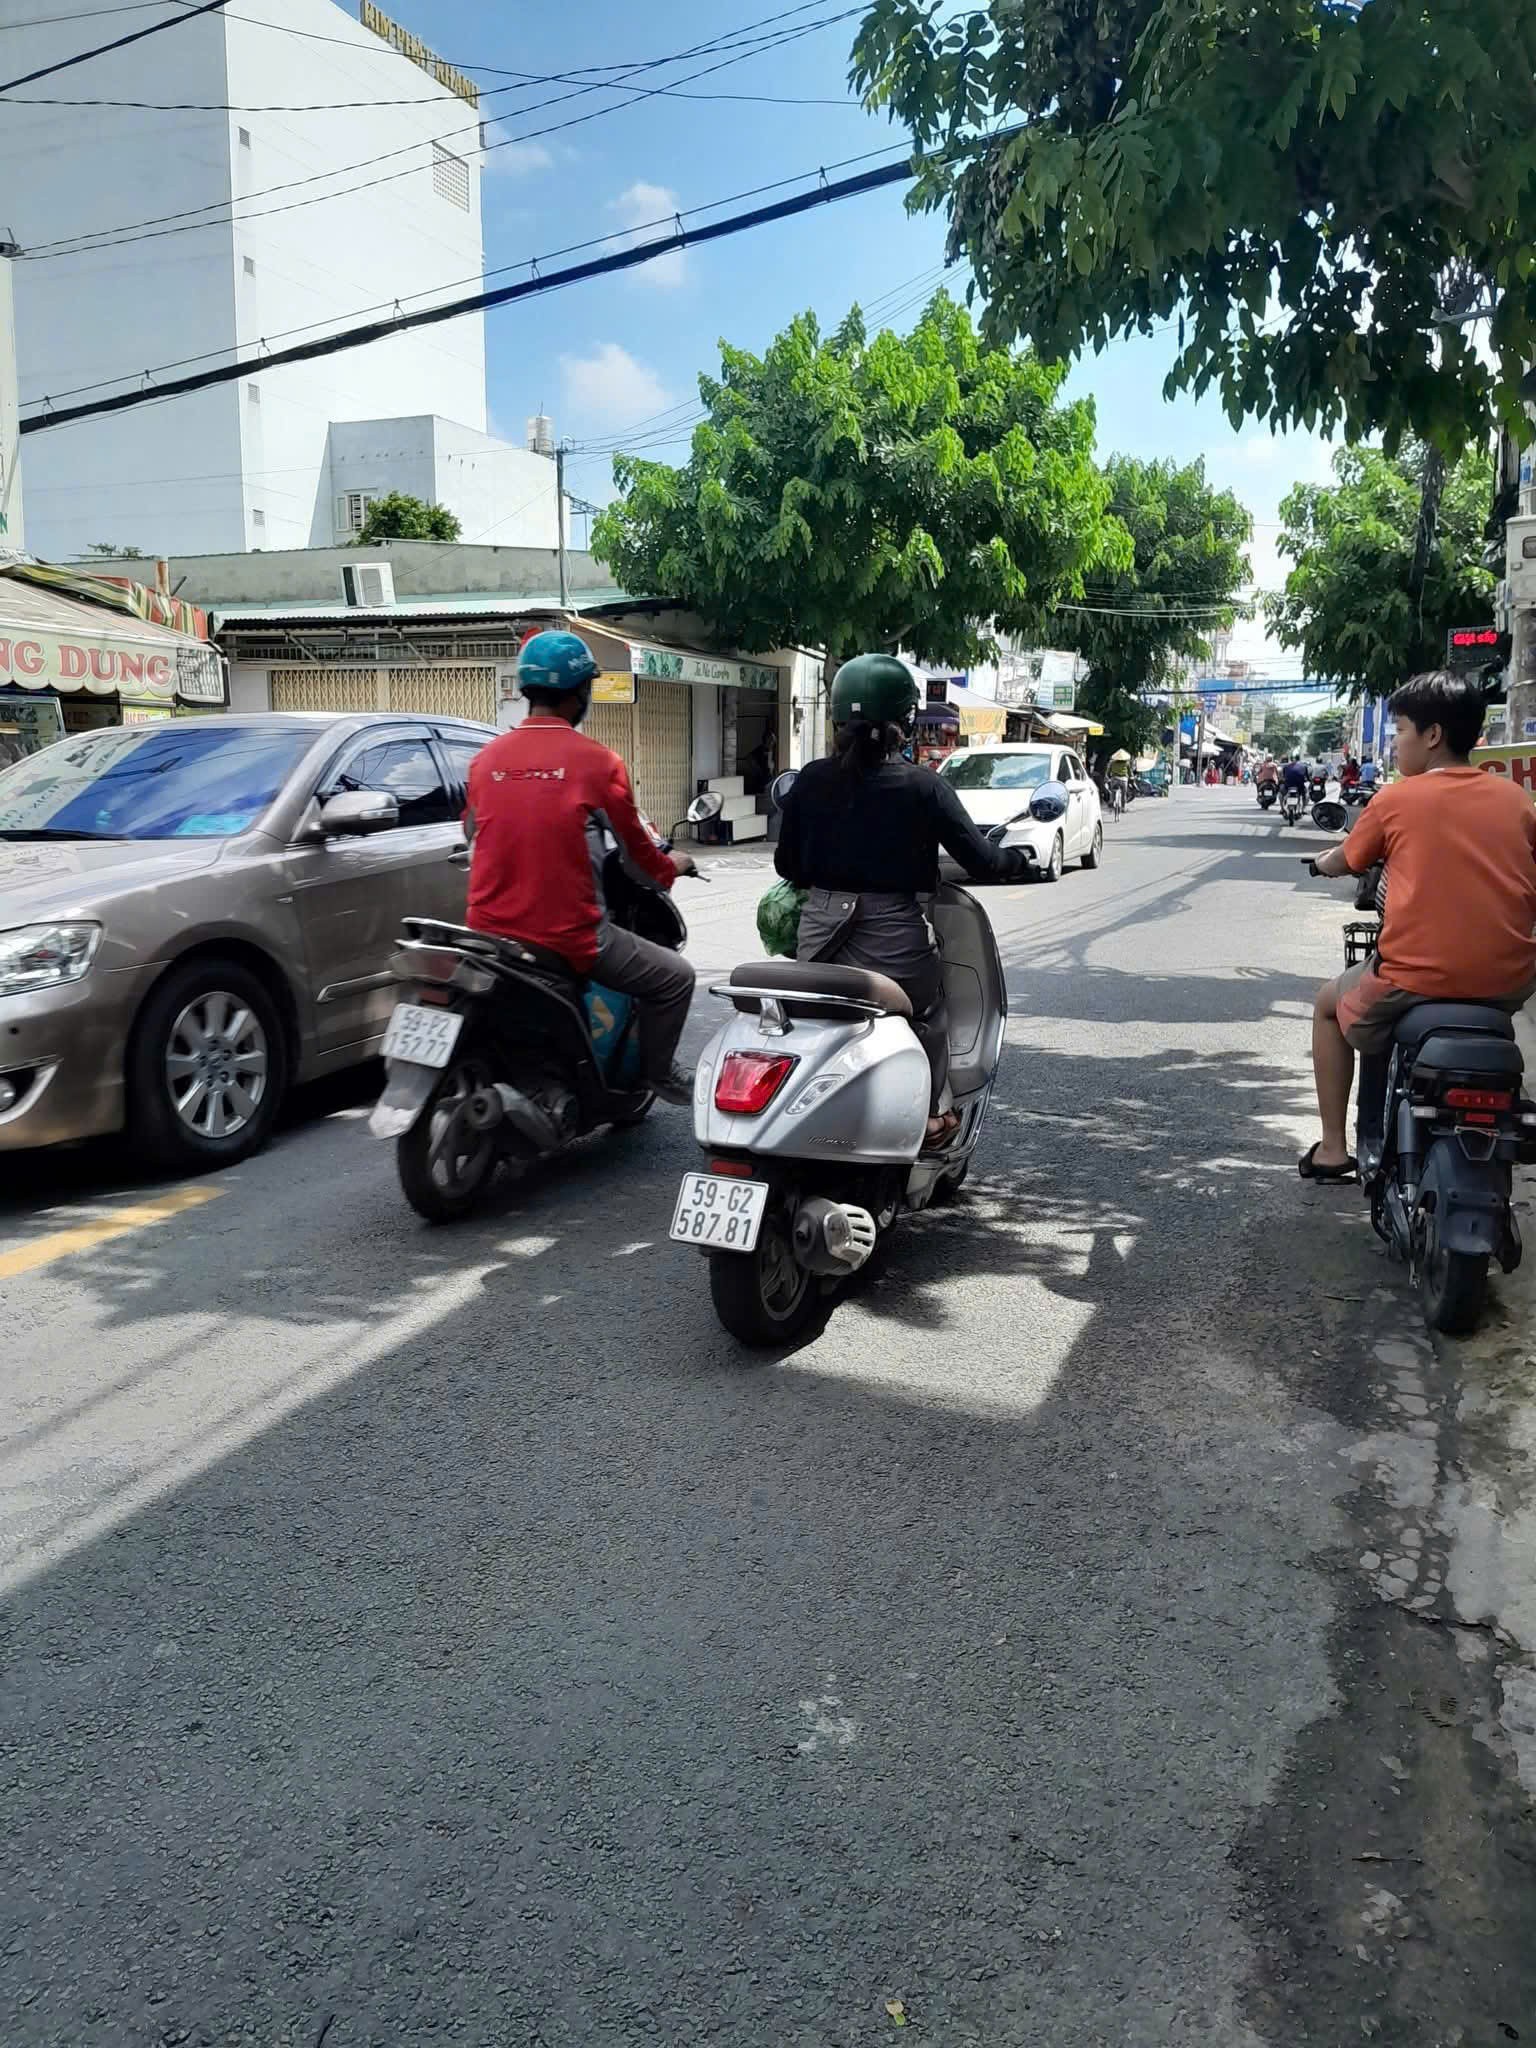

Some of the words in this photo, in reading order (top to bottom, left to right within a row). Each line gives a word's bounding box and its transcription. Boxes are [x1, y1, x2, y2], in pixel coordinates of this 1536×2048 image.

[58, 645, 170, 685] DUNG
[692, 1180, 753, 1213] 59-G2
[677, 1209, 751, 1245] 587.81
